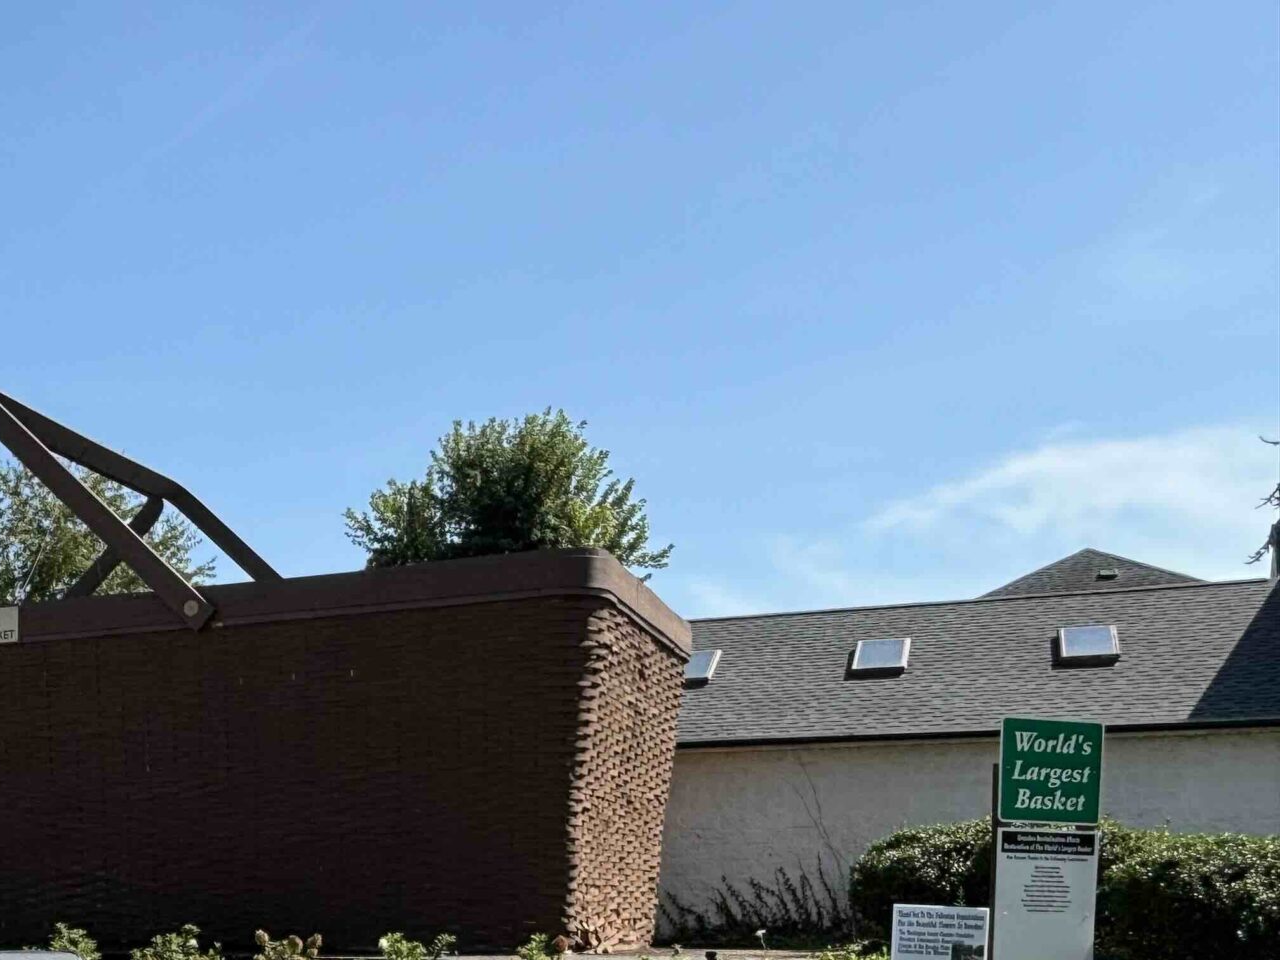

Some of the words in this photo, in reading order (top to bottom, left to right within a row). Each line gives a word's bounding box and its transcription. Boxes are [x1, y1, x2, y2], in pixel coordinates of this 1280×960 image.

[1014, 731, 1093, 755] World's
[1011, 760, 1091, 788] Largest
[1014, 788, 1086, 811] Basket
